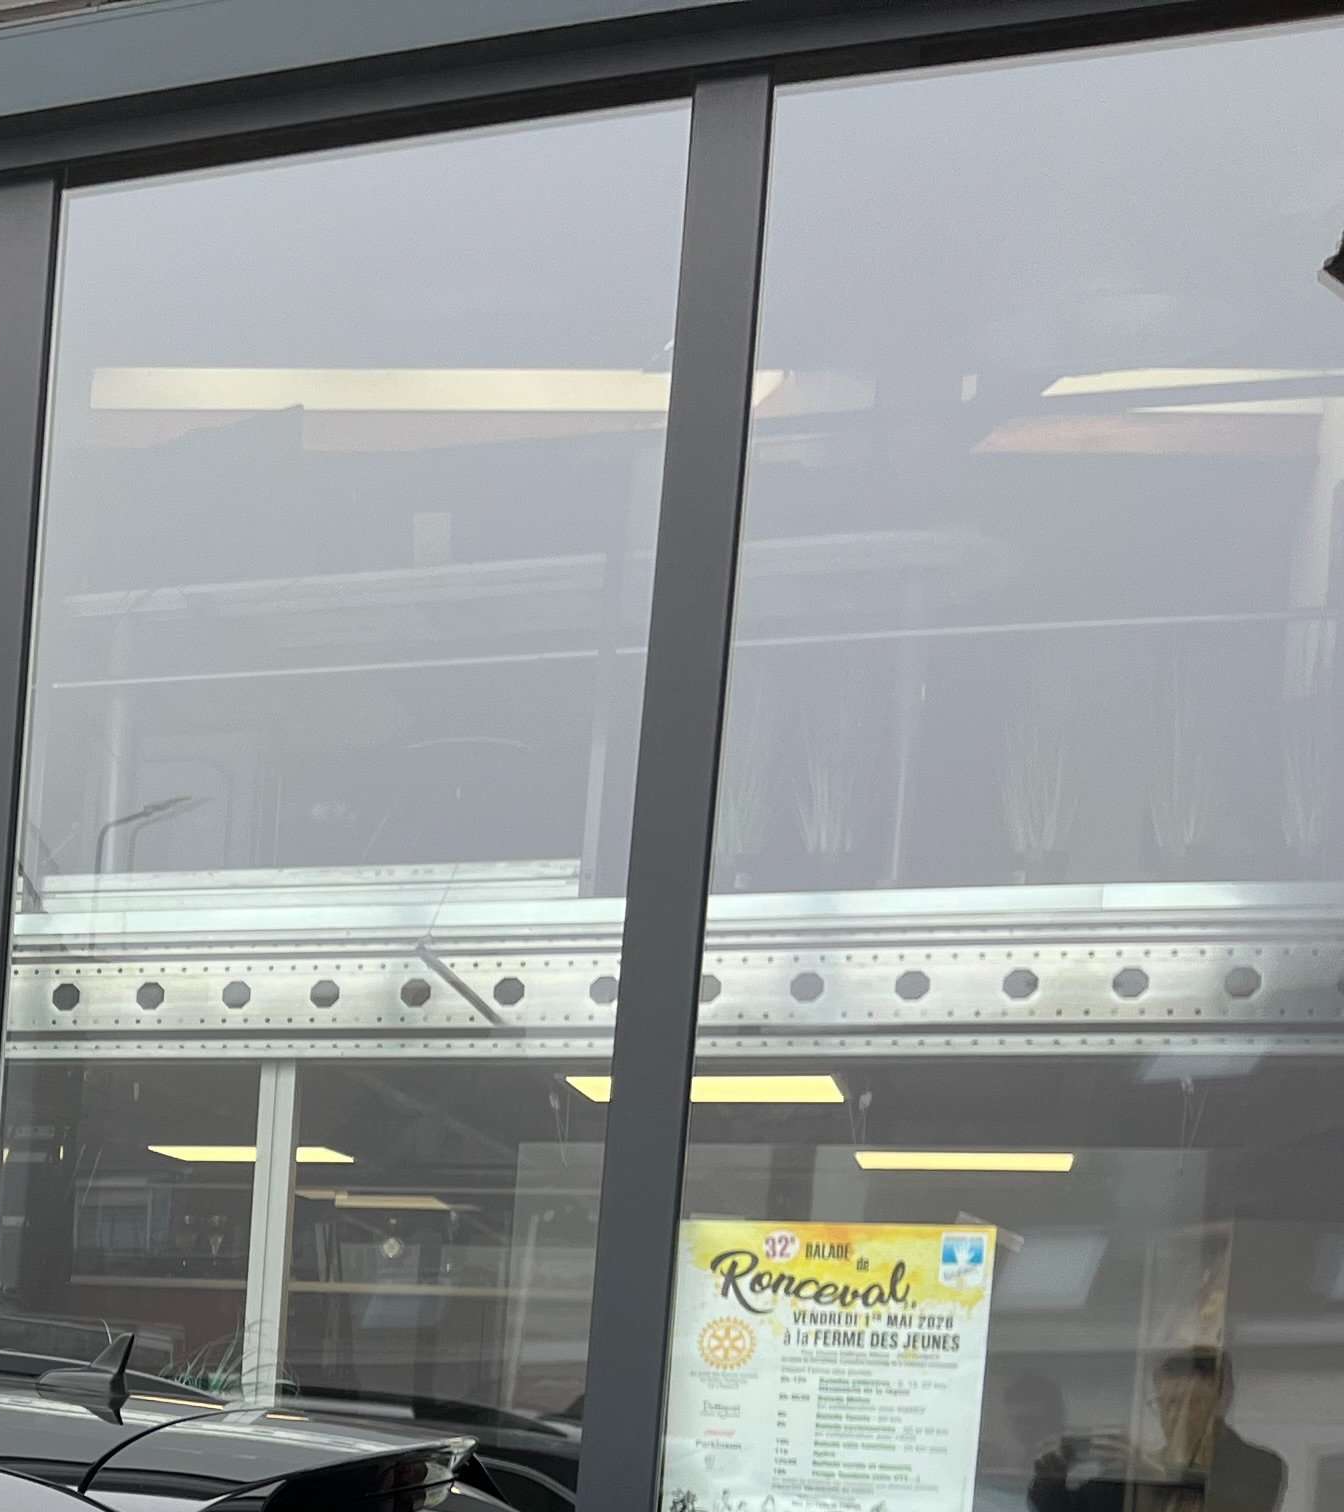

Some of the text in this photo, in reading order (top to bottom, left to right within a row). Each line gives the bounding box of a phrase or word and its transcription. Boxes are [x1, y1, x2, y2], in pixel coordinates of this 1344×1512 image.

[805, 1240, 851, 1261] BALADE
[856, 1257, 870, 1272] de
[710, 1249, 911, 1315] Ronceval
[793, 1309, 858, 1326] VENDREDI
[886, 1313, 913, 1329] MAI
[796, 1328, 809, 1345] la
[813, 1328, 866, 1349] FERME
[870, 1331, 899, 1350] DES
[902, 1331, 961, 1352] JEUNES
